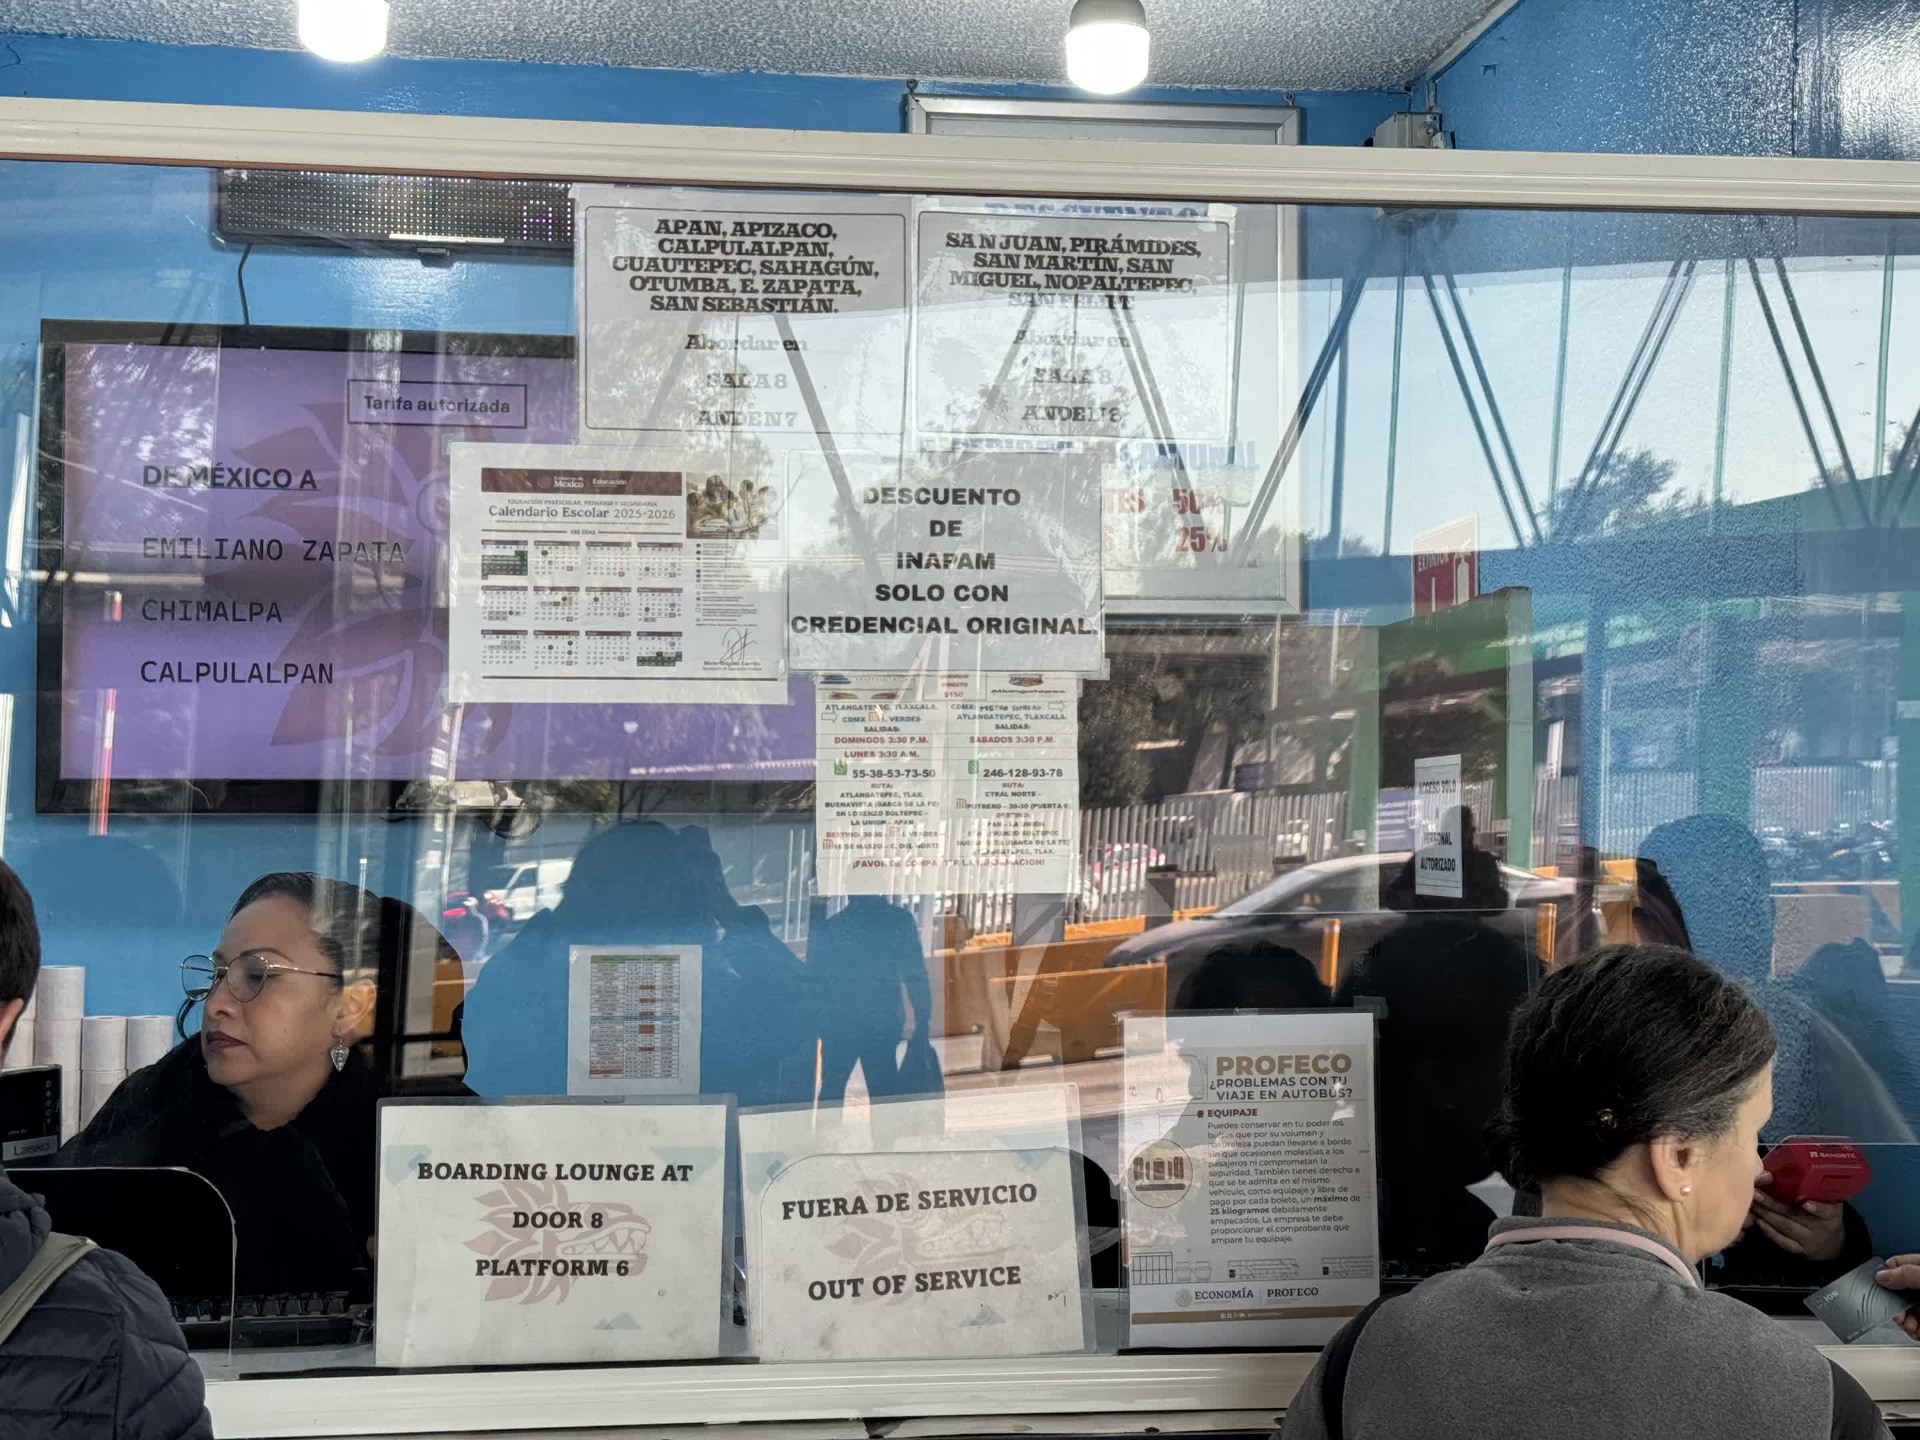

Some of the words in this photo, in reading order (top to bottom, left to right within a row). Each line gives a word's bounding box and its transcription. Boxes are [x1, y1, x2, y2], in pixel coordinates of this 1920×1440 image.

[655, 219, 728, 239] APAN,
[730, 221, 838, 241] APIZACO,
[658, 238, 834, 259] CALPULALPAN,
[946, 232, 995, 249] SAN
[1000, 234, 1067, 254] JUAN,
[1070, 233, 1202, 259] PIRÁMIDES,
[612, 256, 757, 277] CUAUTEPEC,
[760, 255, 879, 280] SAHAGÚN,
[973, 252, 1021, 269] SAN
[1024, 253, 1124, 275] MARTÍN,
[1126, 258, 1174, 274] SAN
[629, 275, 737, 296] OTUMBA,
[762, 279, 862, 298] ZAPATA,
[950, 271, 1041, 291] MIGUEL,
[1044, 274, 1198, 296] NOPALTEPEC,
[650, 296, 698, 312] SAN
[702, 292, 839, 314] SEBASTIÁN.
[685, 334, 779, 351] Abordar
[783, 339, 809, 351] en
[707, 372, 772, 389] SALA
[774, 372, 788, 389] 8
[364, 395, 413, 412] Tarifa
[416, 397, 511, 414] autorizada
[785, 411, 798, 428] 7
[142, 465, 180, 487] DE
[187, 462, 292, 489] MÉXICO
[299, 469, 318, 489] A
[863, 487, 1021, 506] DESCUENTO
[488, 505, 558, 518] Calendario
[562, 506, 609, 519] Escolar
[613, 509, 676, 520] 2025-2026
[929, 520, 963, 537] DE
[1174, 526, 1228, 552] 25%
[142, 536, 283, 561] EMILIANO
[302, 540, 405, 564] ZAPATA
[896, 552, 996, 570] INAPAM
[875, 584, 945, 602] SOLO
[954, 585, 1009, 602] CON
[141, 599, 282, 623] CHIMALPA
[791, 616, 958, 635] CREDENCIAL
[966, 617, 1098, 636] ORIGINAL.
[141, 660, 334, 685] CALPULALPAN
[834, 736, 885, 744] DOMINGOS
[844, 750, 876, 758] LUNES
[852, 769, 936, 778] 55-38-53-73-50
[983, 768, 1063, 778] 246-128-93-78
[1420, 857, 1456, 872] AUTORIZADO
[1216, 1054, 1352, 1076] PROFECO
[1210, 1076, 1296, 1090] ¿PROBLEMAS
[1299, 1076, 1327, 1087] CON
[1331, 1075, 1347, 1086] TU
[1216, 1090, 1255, 1100] VIAJE
[1260, 1090, 1276, 1099] EN
[1207, 1108, 1258, 1119] EQUIPAJE
[1208, 1121, 1238, 1129] Puedes
[1240, 1120, 1280, 1129] conservar
[1282, 1120, 1294, 1128] en
[1306, 1119, 1330, 1129] poder
[1235, 1131, 1252, 1140] que
[1254, 1130, 1267, 1139] por
[1270, 1130, 1279, 1138] su
[1281, 1128, 1318, 1137] volumen
[1253, 1138, 1286, 1148] puedan
[1287, 1137, 1318, 1147] llevarse
[1327, 1136, 1352, 1146] bordo
[1222, 1150, 1239, 1159] que
[1240, 1148, 1282, 1158] ocasionen
[1284, 1147, 1323, 1157] molestias
[1332, 1146, 1344, 1155] los
[1208, 1160, 1247, 1169] pasajeros
[1259, 1158, 1318, 1167] comprometan
[1320, 1157, 1327, 1165] la
[417, 1163, 547, 1181] BOARDING
[555, 1163, 655, 1182] LOUNGE
[661, 1164, 694, 1182] AT
[1209, 1169, 1252, 1178] seguridad.
[1254, 1167, 1290, 1176] También
[1292, 1166, 1317, 1175] tienes
[1319, 1166, 1353, 1174] derecho
[1209, 1179, 1225, 1188] que
[1227, 1179, 1236, 1187] se
[1238, 1178, 1247, 1186] te
[1248, 1177, 1278, 1186] admita
[1301, 1176, 1331, 1184] mismo
[1209, 1188, 1246, 1197] vehículo,
[1248, 1188, 1271, 1196] como
[1273, 1186, 1309, 1196] equipaje
[1317, 1185, 1336, 1194] libre
[1338, 1185, 1349, 1193] de
[781, 1195, 869, 1220] FUERA
[875, 1192, 910, 1213] DE
[917, 1183, 1038, 1211] SERVICIO
[1209, 1199, 1231, 1208] pago
[1233, 1198, 1247, 1206] por
[1248, 1197, 1269, 1205] cada
[1271, 1196, 1299, 1205] boleto,
[1301, 1196, 1312, 1204] un
[1313, 1194, 1349, 1203] máximo
[1350, 1194, 1361, 1202] de
[1209, 1207, 1220, 1215] 25
[1222, 1206, 1270, 1216] kilogramos
[1271, 1205, 1327, 1214] debidamente
[512, 1211, 583, 1229] DOOR
[590, 1212, 604, 1229] 8
[1210, 1217, 1260, 1226] empacados.
[1262, 1216, 1272, 1224] La
[1274, 1216, 1310, 1225] empresa
[1322, 1214, 1344, 1222] debe
[1210, 1226, 1264, 1236] proporcionar
[1275, 1223, 1331, 1234] comprobante
[1333, 1224, 1349, 1233] que
[1211, 1236, 1243, 1245] ampare
[1256, 1234, 1293, 1244] equipaje.
[475, 1259, 609, 1277] PLATFORM
[616, 1259, 630, 1277] 6
[807, 1277, 864, 1301] OUT
[872, 1274, 907, 1297] OF
[915, 1265, 1021, 1293] SERVICE
[1194, 1286, 1254, 1300] ECONOMÍA
[1267, 1286, 1319, 1298] PROFECO
